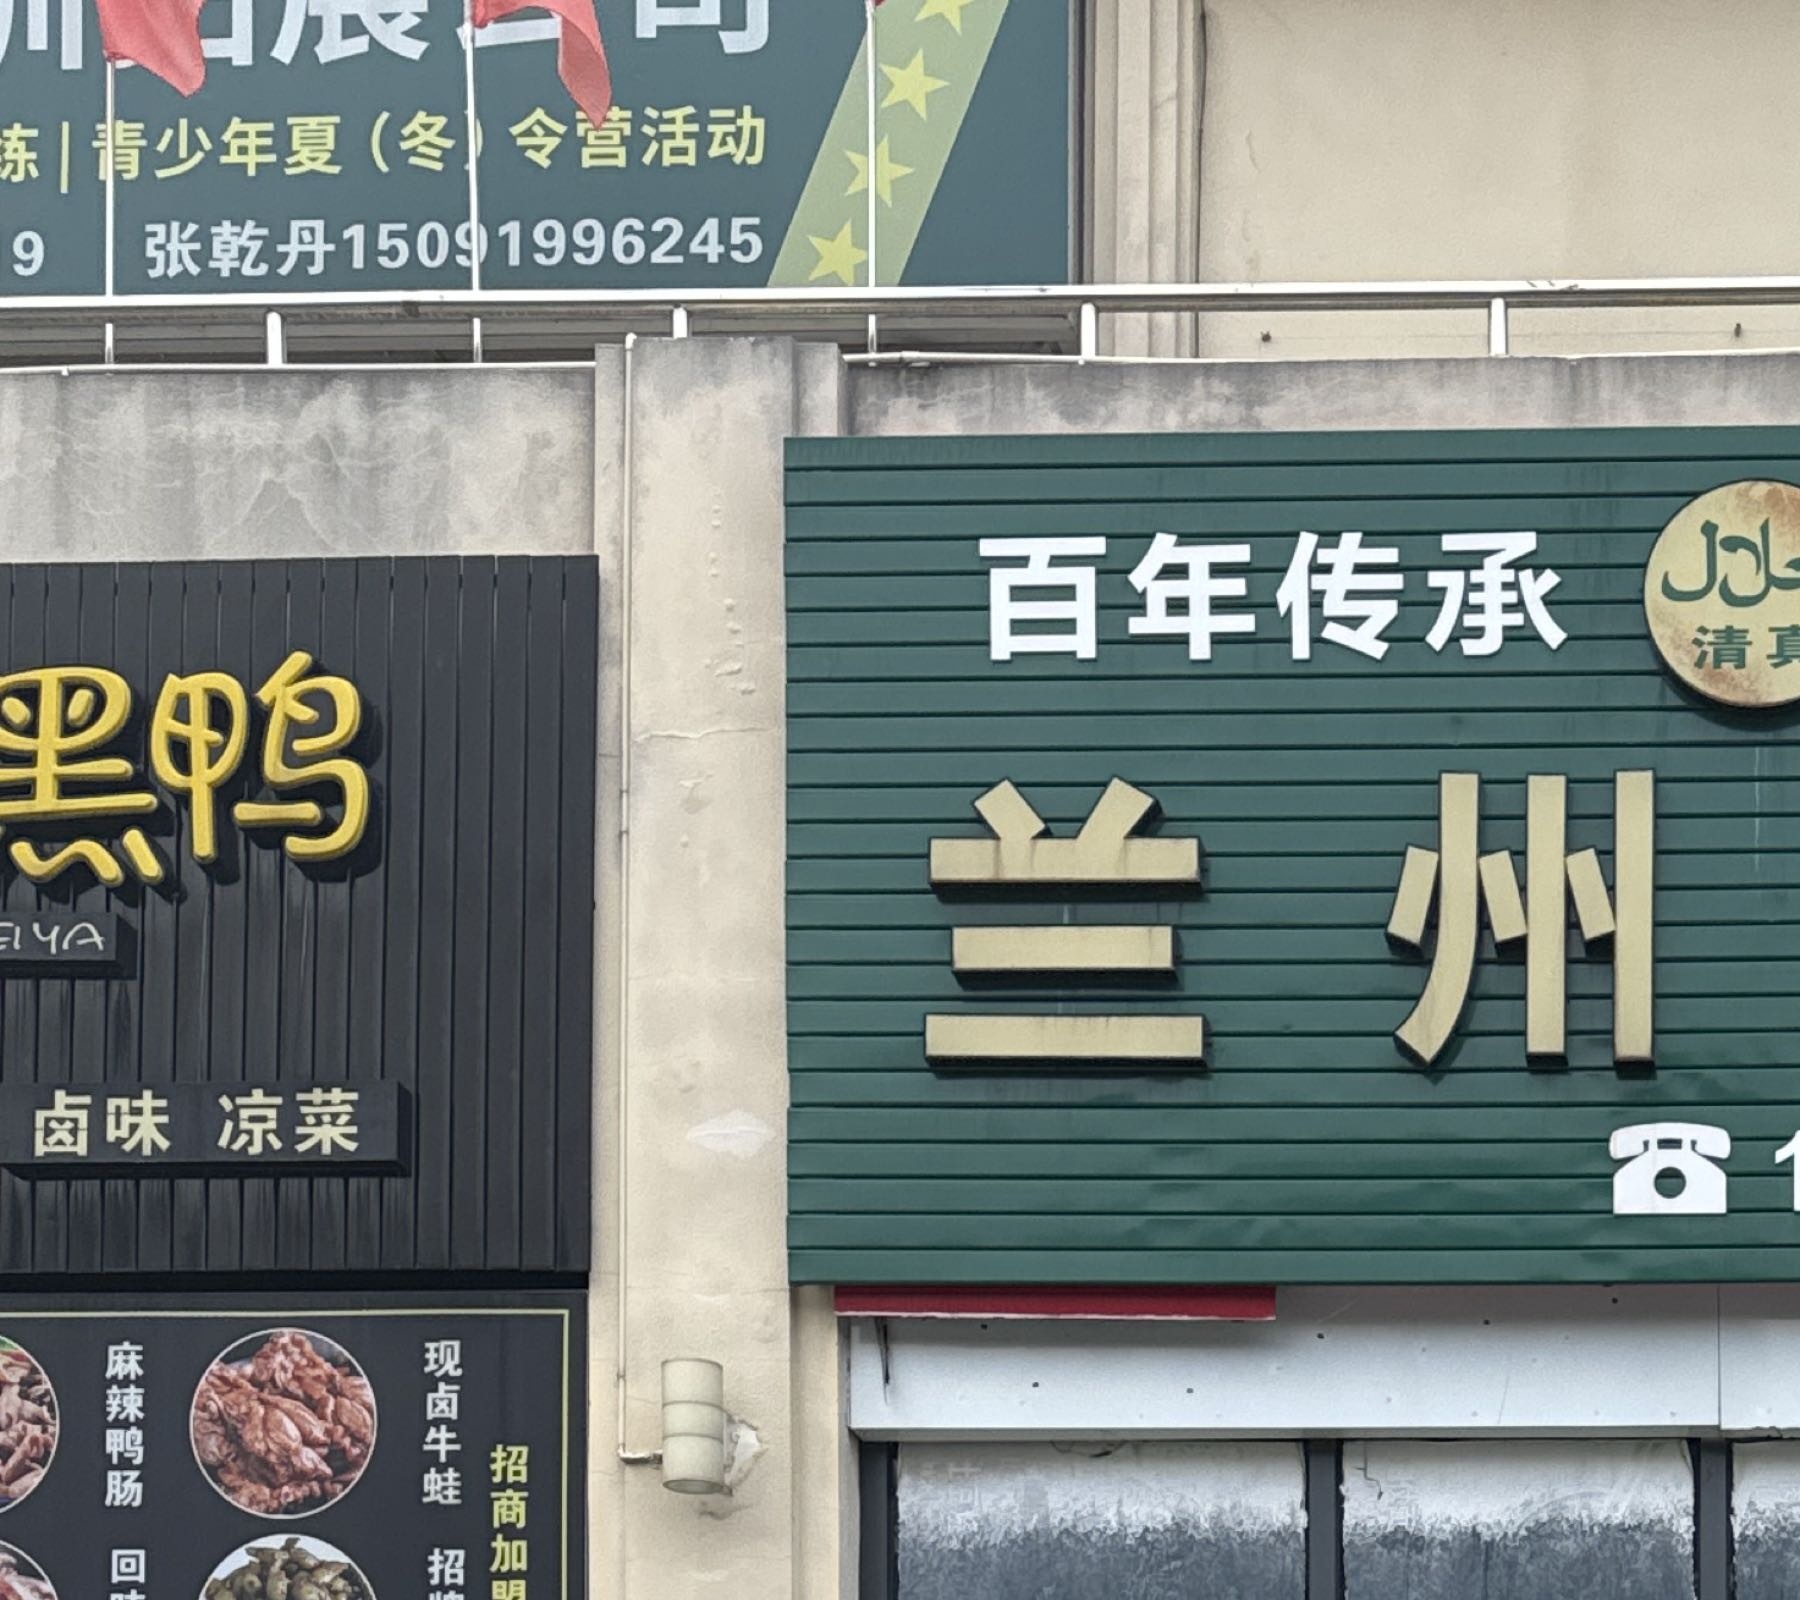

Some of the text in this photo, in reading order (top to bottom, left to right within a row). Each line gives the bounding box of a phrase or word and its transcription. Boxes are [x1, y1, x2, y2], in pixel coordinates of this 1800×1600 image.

[12, 230, 46, 276] 9
[978, 530, 1569, 662] 百年传承
[33, 1086, 360, 1158] 卤味 凉菜
[104, 1340, 146, 1508] 麻辣鸭肠
[421, 1339, 464, 1505] 现卤牛蛙
